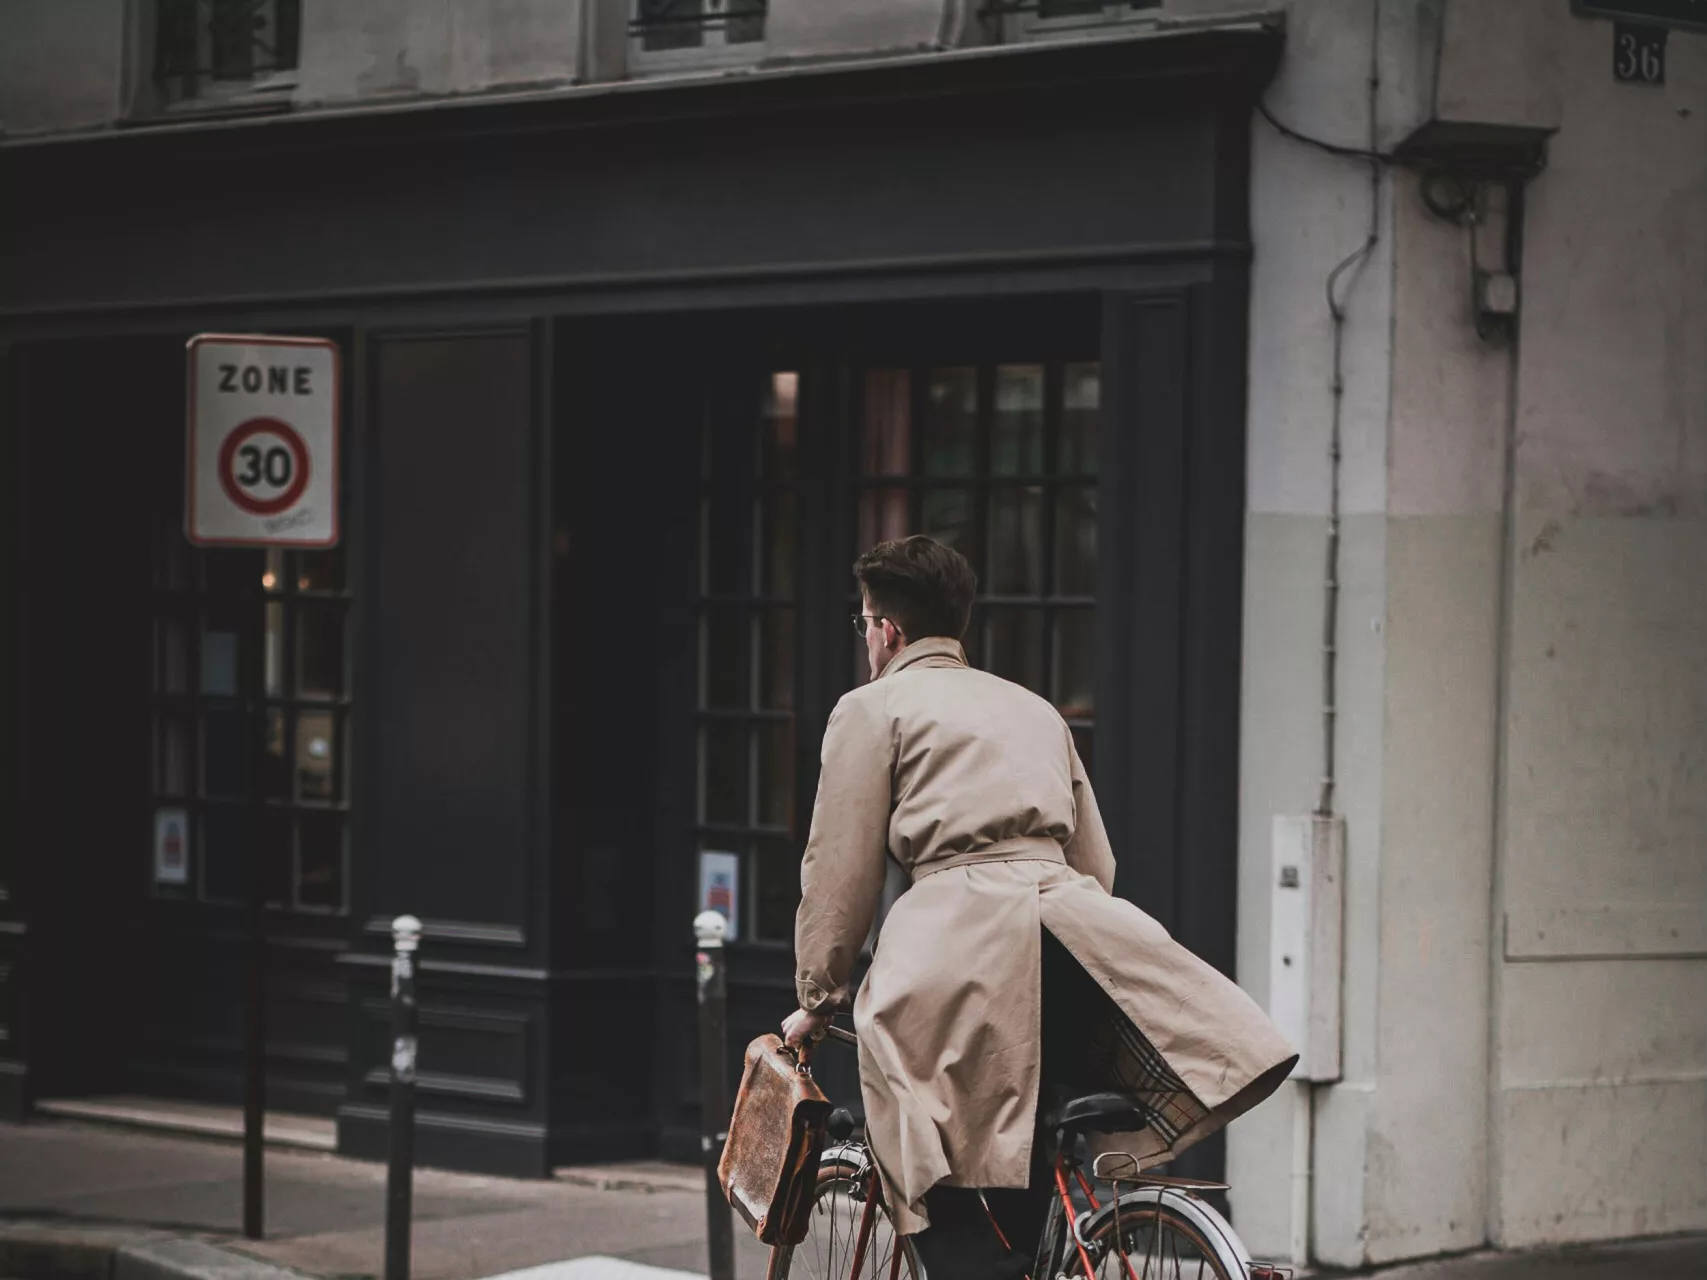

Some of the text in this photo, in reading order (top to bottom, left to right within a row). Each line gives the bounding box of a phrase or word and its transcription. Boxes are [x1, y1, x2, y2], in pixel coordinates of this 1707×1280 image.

[1618, 33, 1660, 80] 36
[217, 364, 314, 395] ZONE
[237, 445, 292, 488] 30
